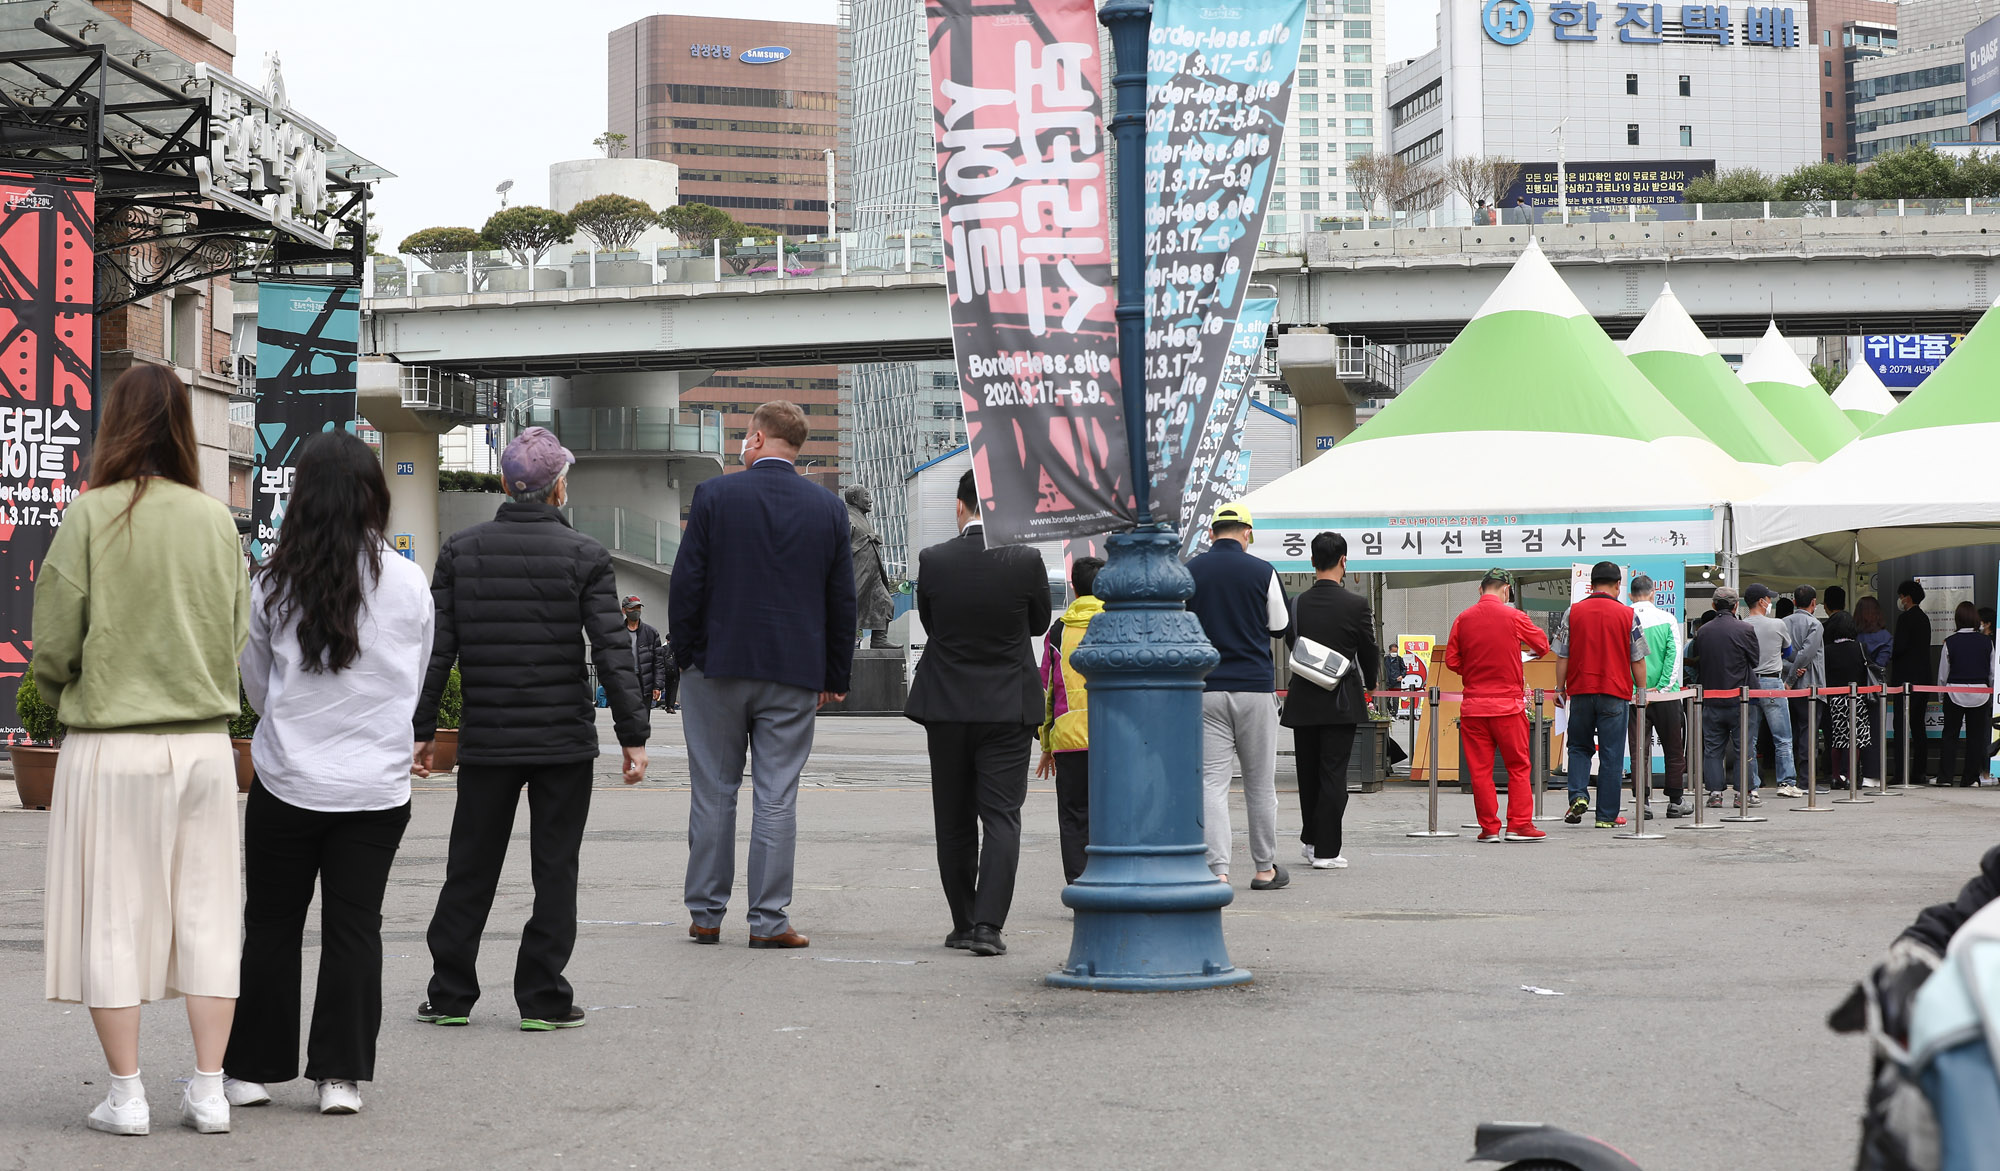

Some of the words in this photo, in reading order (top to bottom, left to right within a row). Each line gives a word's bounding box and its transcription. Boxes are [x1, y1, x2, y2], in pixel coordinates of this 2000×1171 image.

[1550, 0, 1795, 47] 한진택배
[690, 44, 731, 58] 삼성생명
[747, 50, 784, 59] SAMSUNG
[1980, 38, 1998, 66] BASF
[1525, 173, 1541, 182] 모든
[1579, 171, 1611, 182] 비자확인
[1614, 171, 1630, 181] 없이
[1633, 171, 1657, 180] 무료로
[1660, 170, 1684, 180] 검사가
[1525, 183, 1558, 194] 진행되니
[1595, 183, 1631, 193] 코로나19
[1633, 182, 1649, 192] 검사
[1651, 182, 1685, 192] 받으세요
[969, 349, 1111, 378] Border-less.site
[1879, 365, 1887, 374] 총
[1889, 365, 1912, 374] 207개
[1317, 438, 1333, 447] P14
[397, 464, 413, 473] P15
[1388, 515, 1489, 526] 코로나바이러스감염증
[1503, 516, 1517, 525] 19
[1656, 594, 1676, 605] 검사
